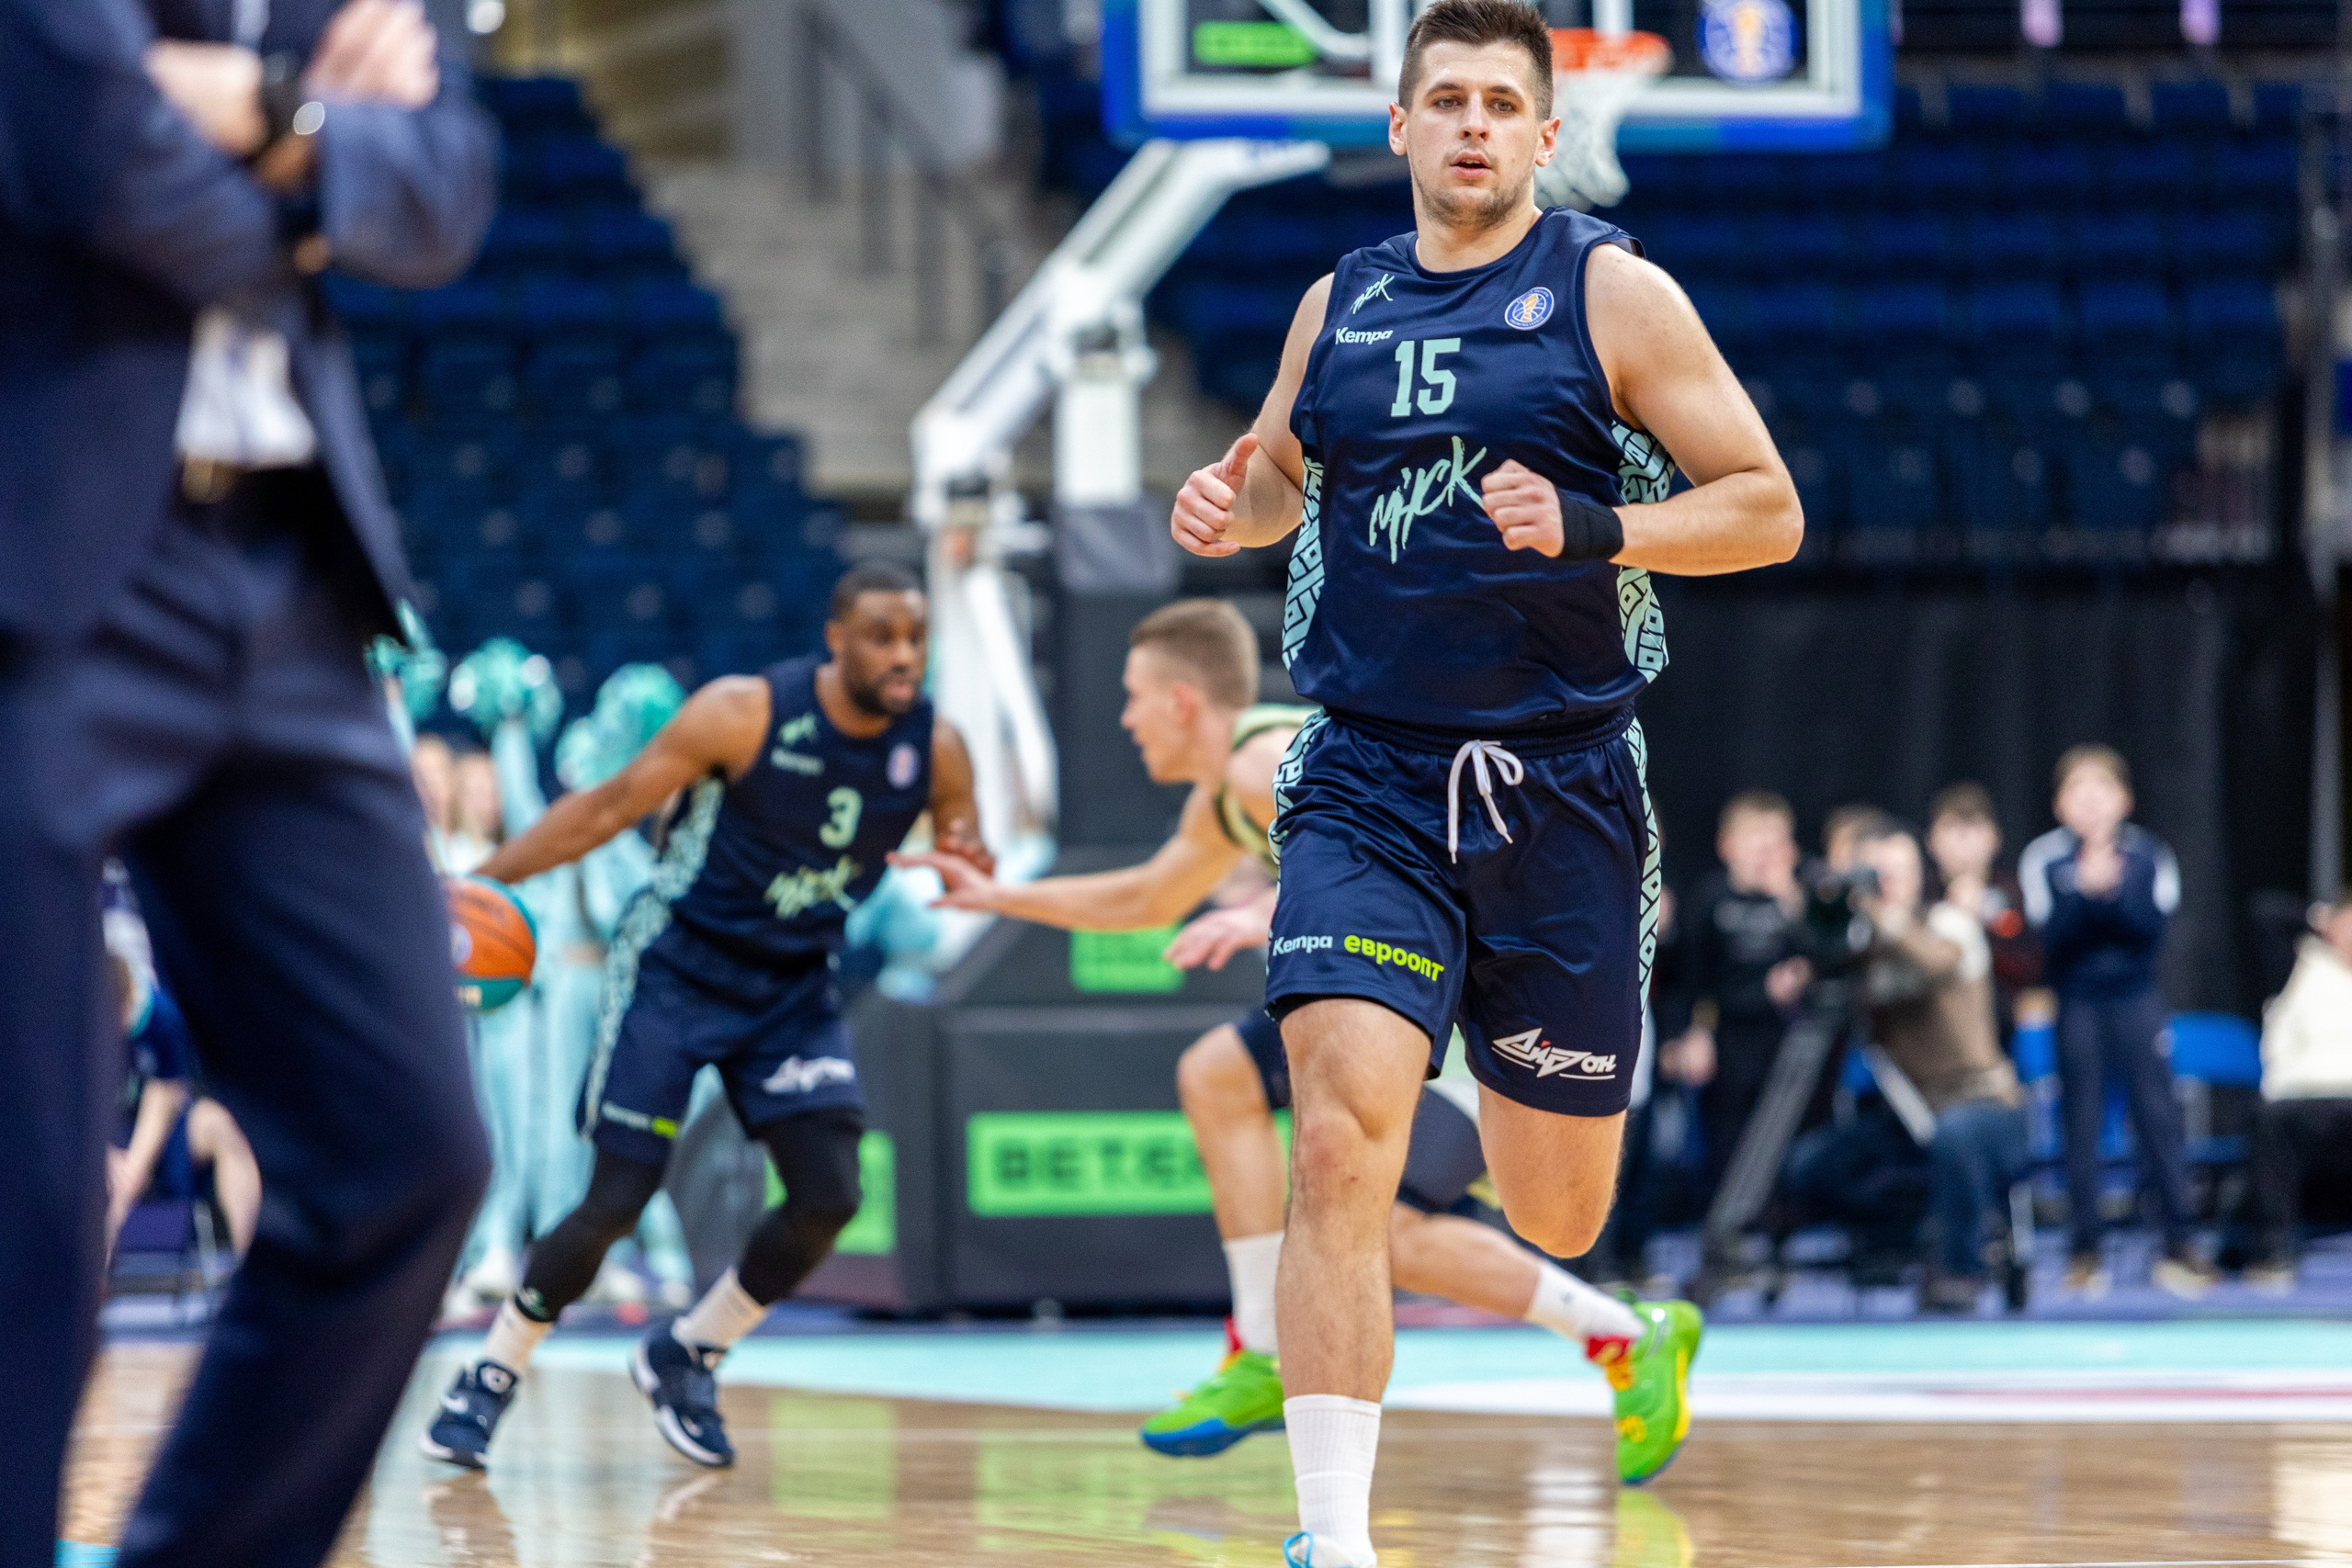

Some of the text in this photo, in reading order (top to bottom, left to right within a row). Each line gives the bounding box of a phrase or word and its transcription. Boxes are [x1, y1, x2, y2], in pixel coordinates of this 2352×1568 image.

[1335, 326, 1394, 345] Kempa
[1390, 336, 1462, 417] 15
[819, 785, 864, 850] 3
[1272, 935, 1333, 956] Kempa
[1343, 934, 1444, 982] евроопт
